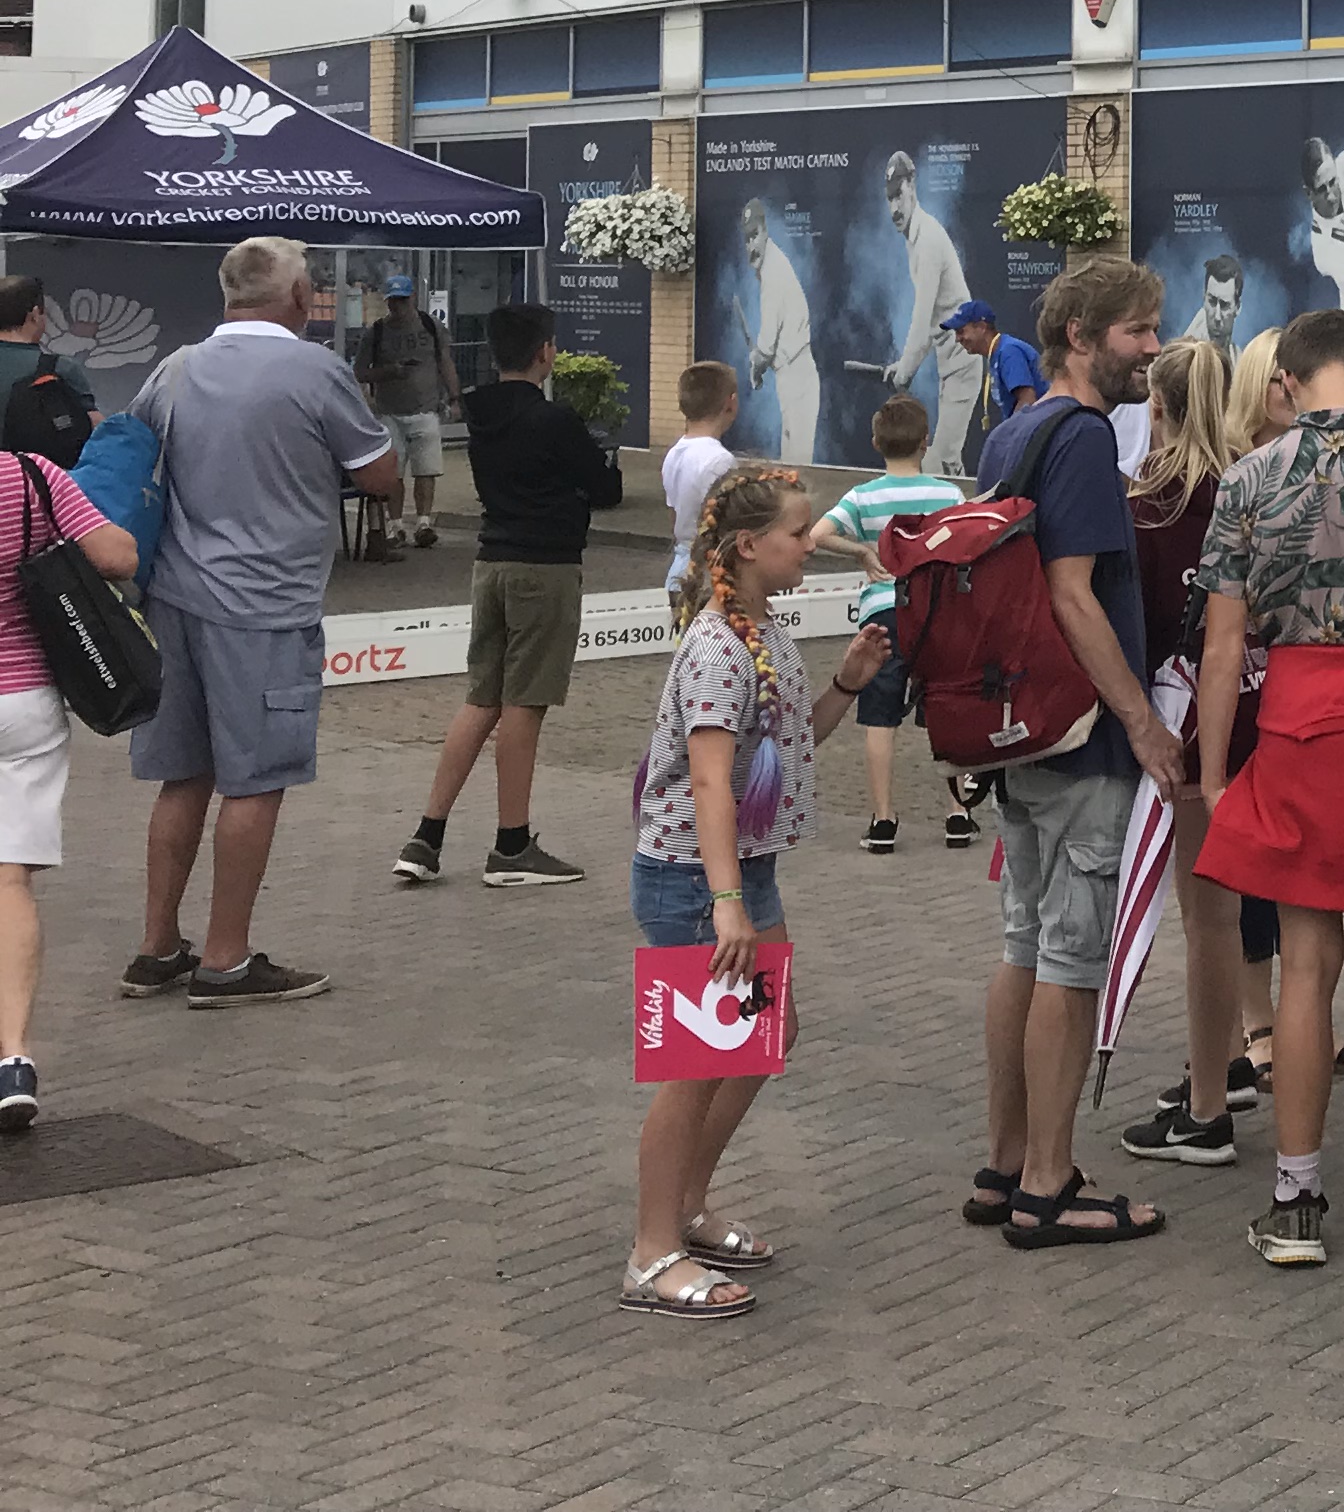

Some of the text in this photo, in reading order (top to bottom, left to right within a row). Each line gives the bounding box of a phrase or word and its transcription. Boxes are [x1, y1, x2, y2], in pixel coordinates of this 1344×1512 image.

[706, 153, 849, 172] ENGLAND'S TEST MATCH CAPTAINS
[144, 168, 363, 187] YORKSHIRE
[155, 185, 371, 196] CRICKET FOUNDATION
[1173, 204, 1218, 217] YARDLEY
[578, 275, 588, 287] OF
[59, 593, 117, 689] eatwelshbeef.com
[594, 625, 665, 647] 654300
[639, 979, 671, 1050] Vitality
[673, 970, 759, 1051] 6
